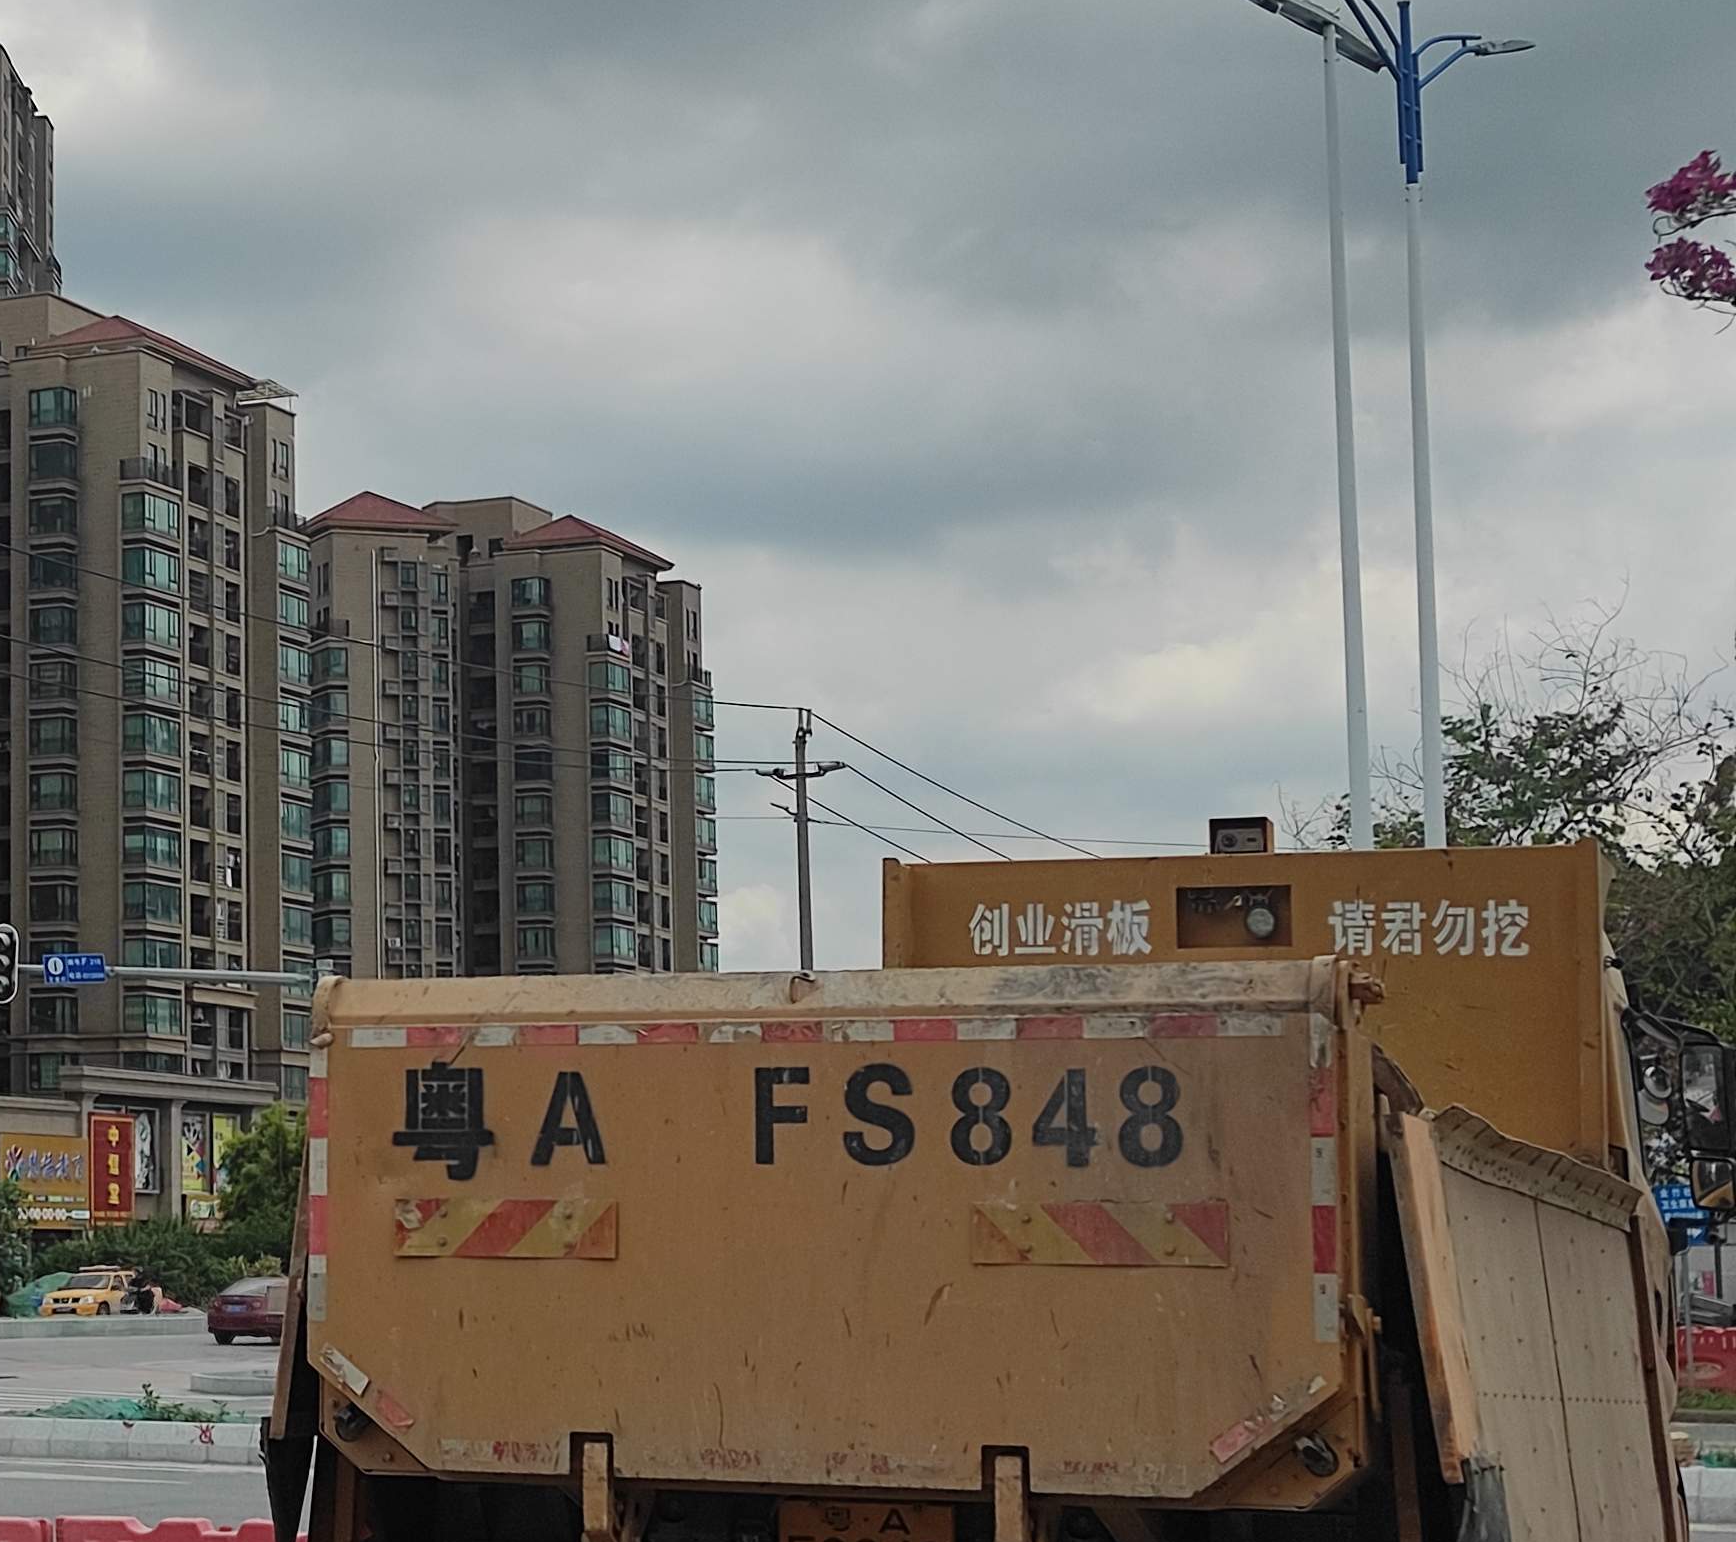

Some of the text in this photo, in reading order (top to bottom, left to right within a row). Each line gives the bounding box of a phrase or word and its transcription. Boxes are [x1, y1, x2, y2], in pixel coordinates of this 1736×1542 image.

[968, 899, 1530, 957] 创业滑板 请君勿挖
[754, 1064, 1185, 1168] FS848
